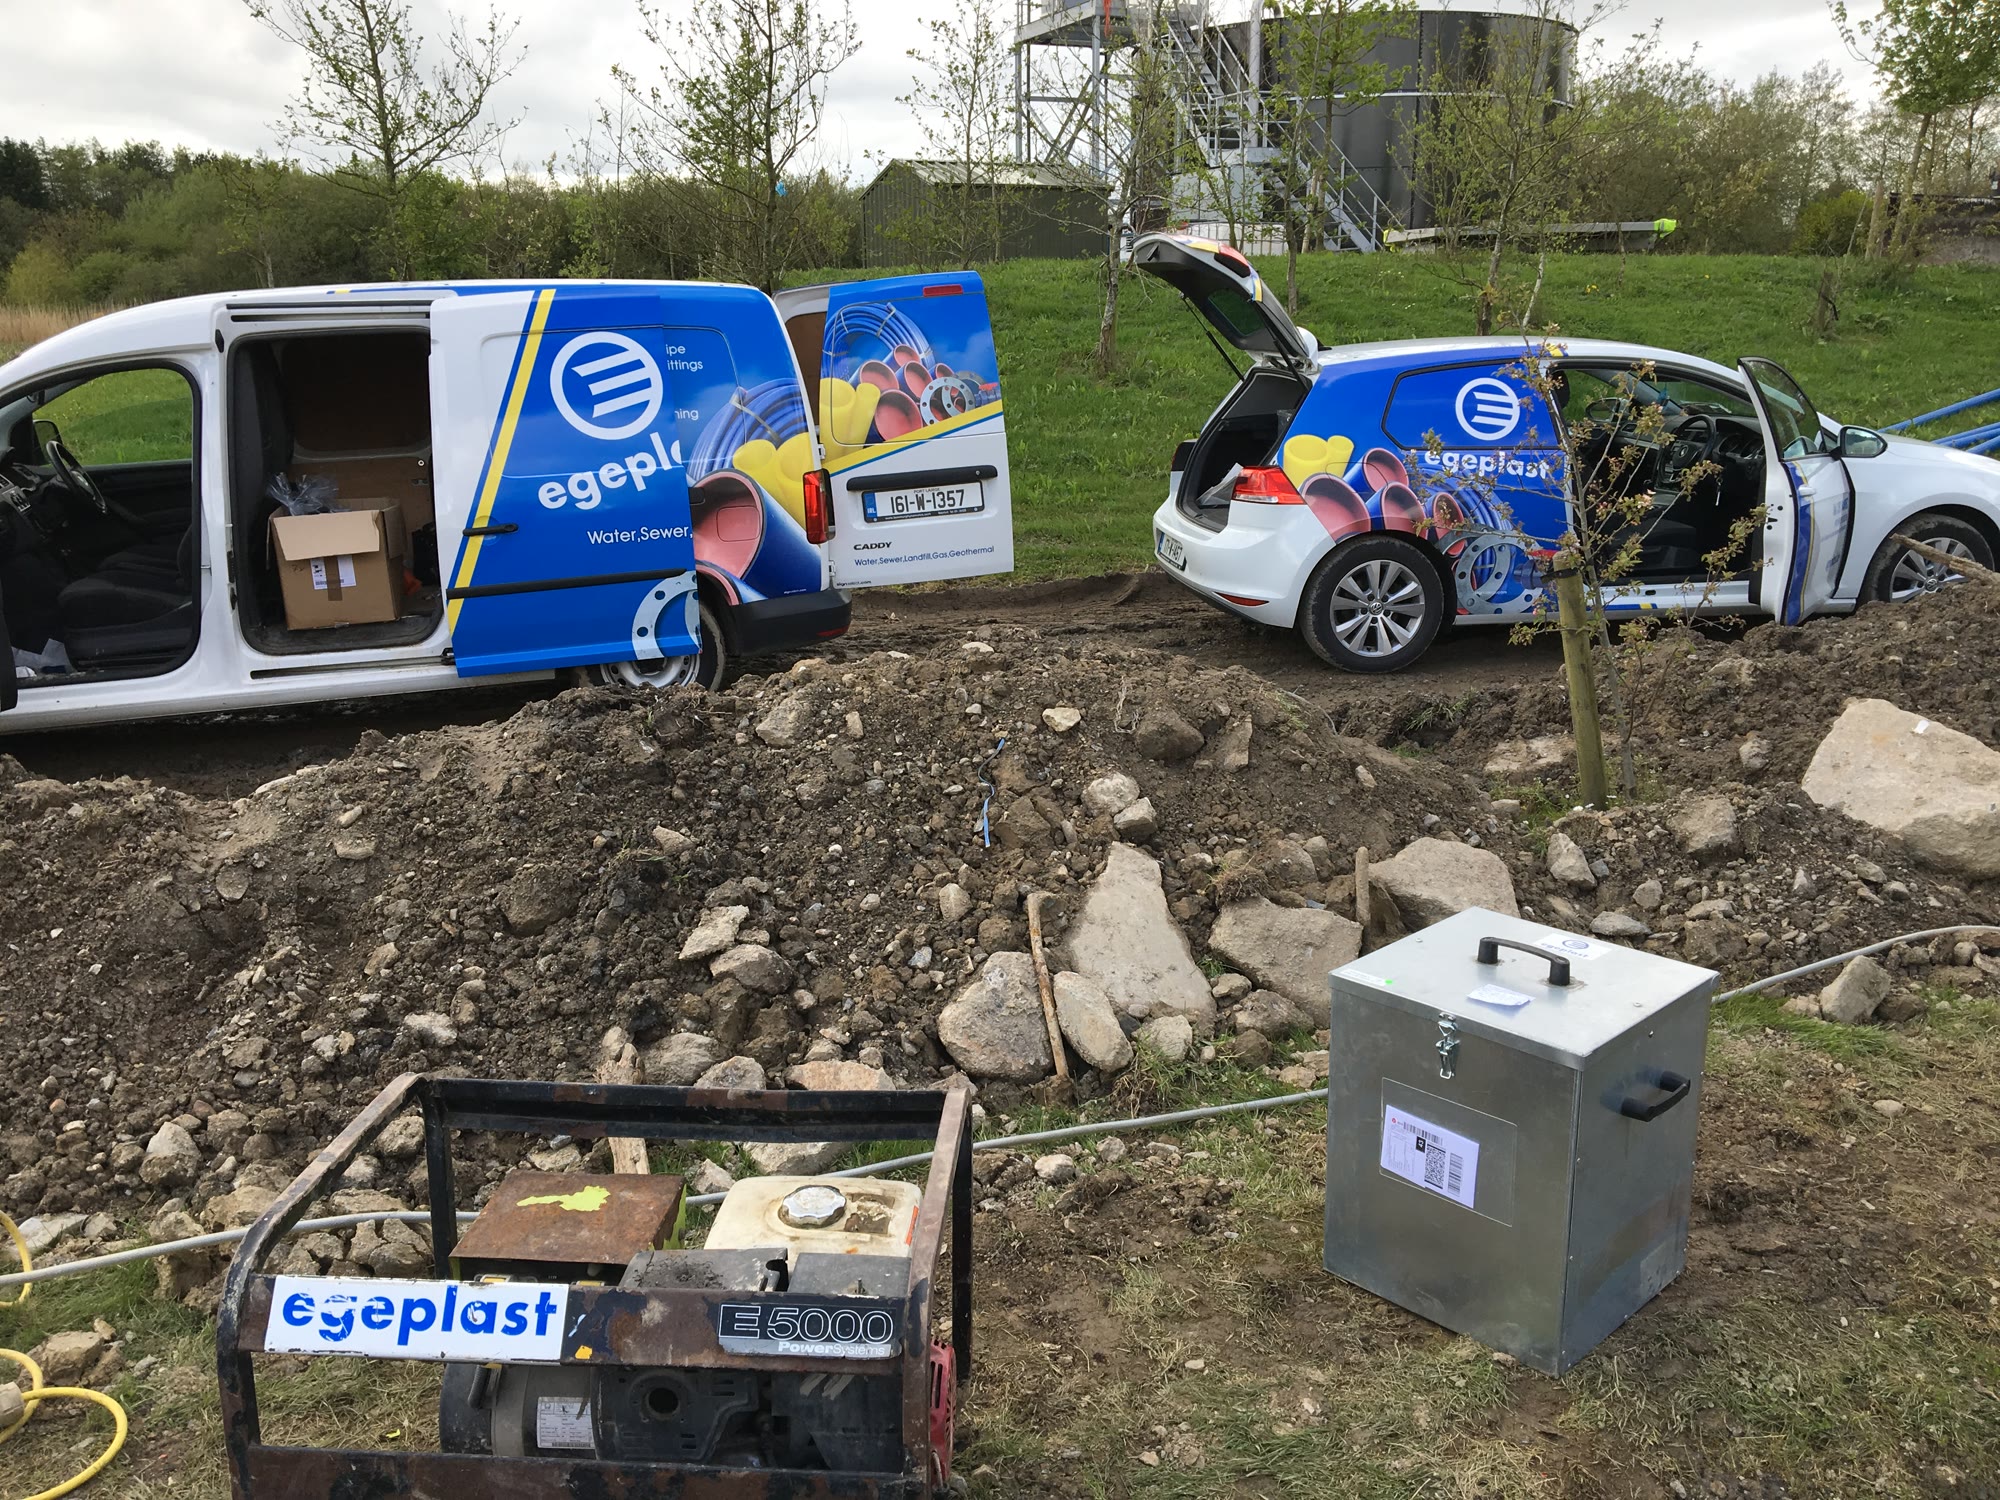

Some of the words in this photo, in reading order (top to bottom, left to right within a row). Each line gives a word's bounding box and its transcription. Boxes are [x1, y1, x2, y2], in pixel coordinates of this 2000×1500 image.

[1424, 450, 1550, 480] egeplast
[890, 488, 965, 514] 161-W-1357
[853, 541, 892, 551] CADDY
[282, 1284, 557, 1346] egeplast
